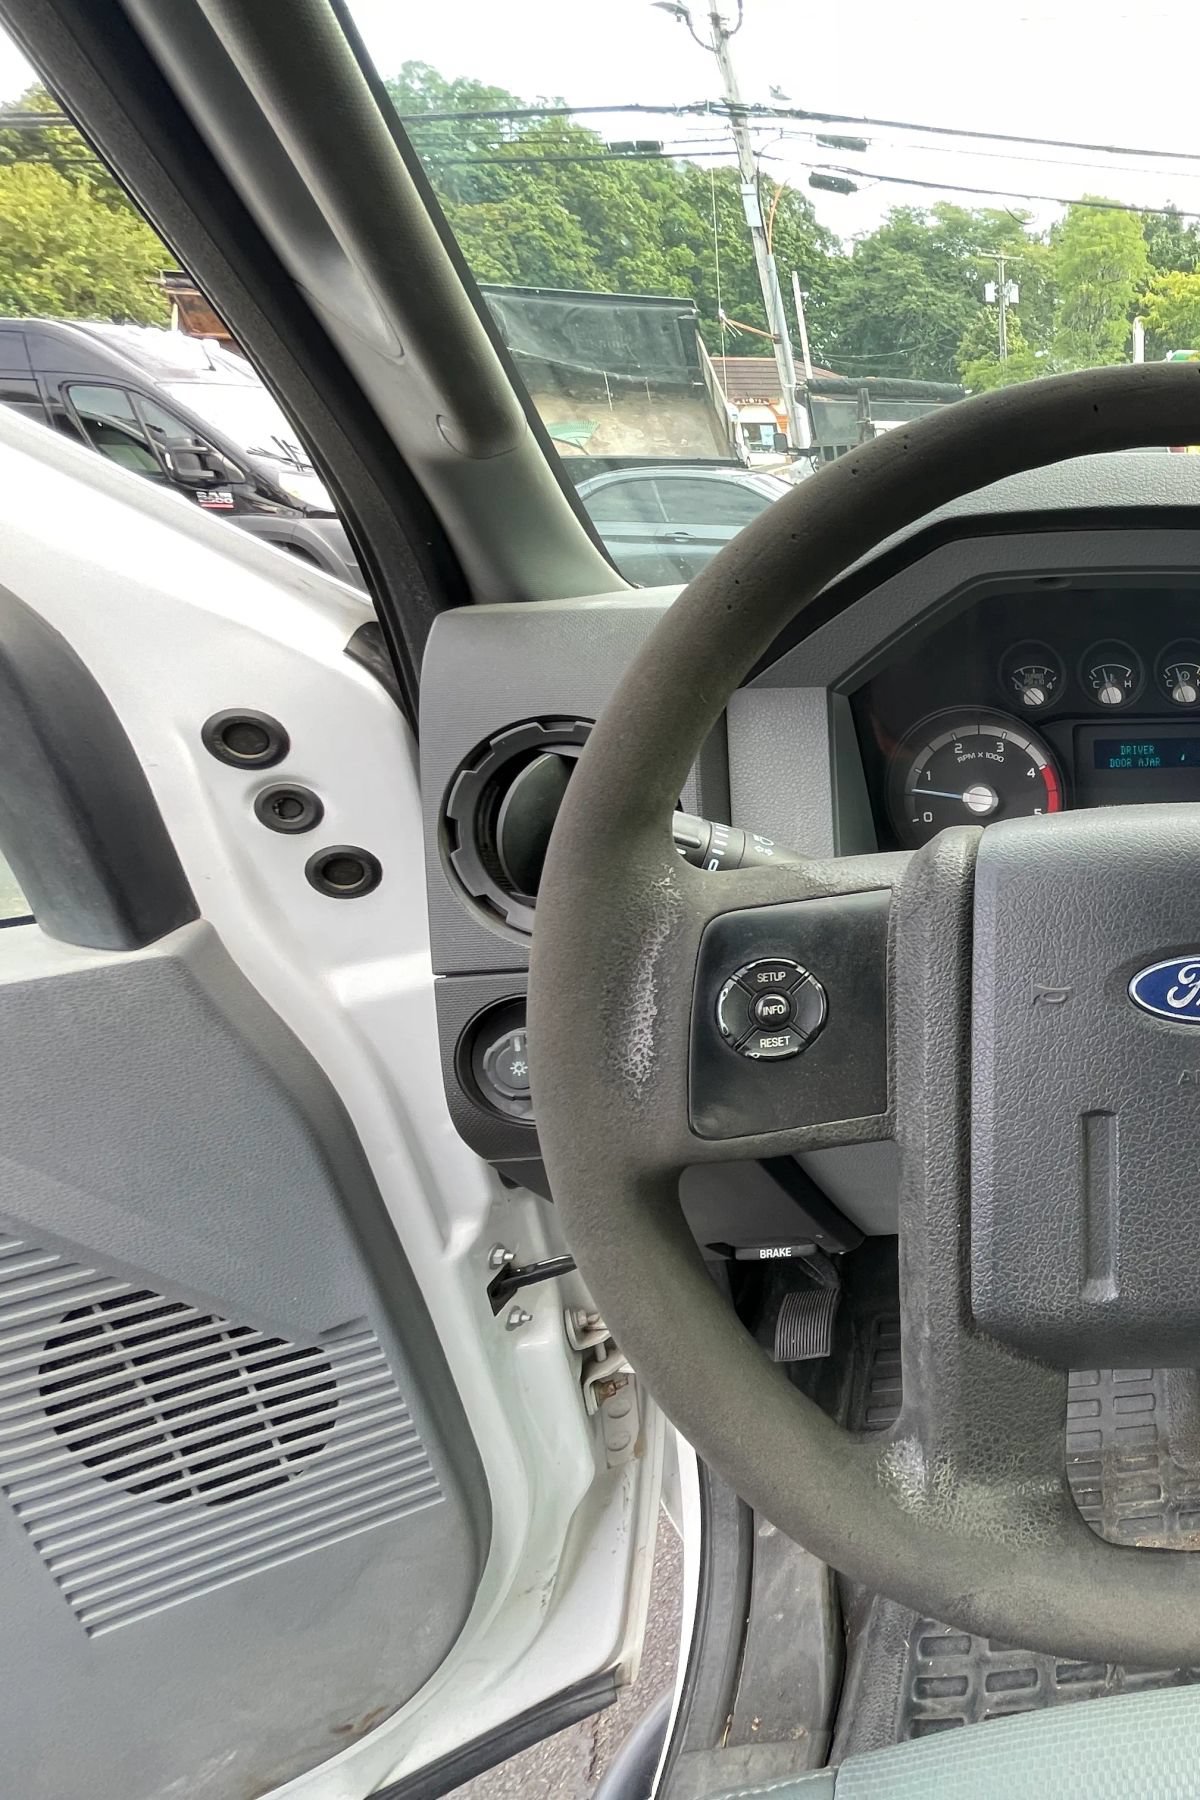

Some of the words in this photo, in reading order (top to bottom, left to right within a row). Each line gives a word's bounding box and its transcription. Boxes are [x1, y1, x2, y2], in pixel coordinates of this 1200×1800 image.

[1124, 680, 1132, 688] H
[954, 743, 963, 754] 2
[996, 742, 1004, 752] 3
[1120, 745, 1155, 755] DRIVER
[1109, 758, 1132, 768] DOOR
[1138, 757, 1161, 767] AJAR
[926, 770, 932, 780] 1
[1026, 767, 1036, 778] 4
[923, 811, 933, 822] 0
[756, 971, 787, 983] SETUP
[762, 1004, 785, 1015] INFO
[759, 1035, 791, 1048] RESET
[759, 1247, 792, 1259] BRAKE
